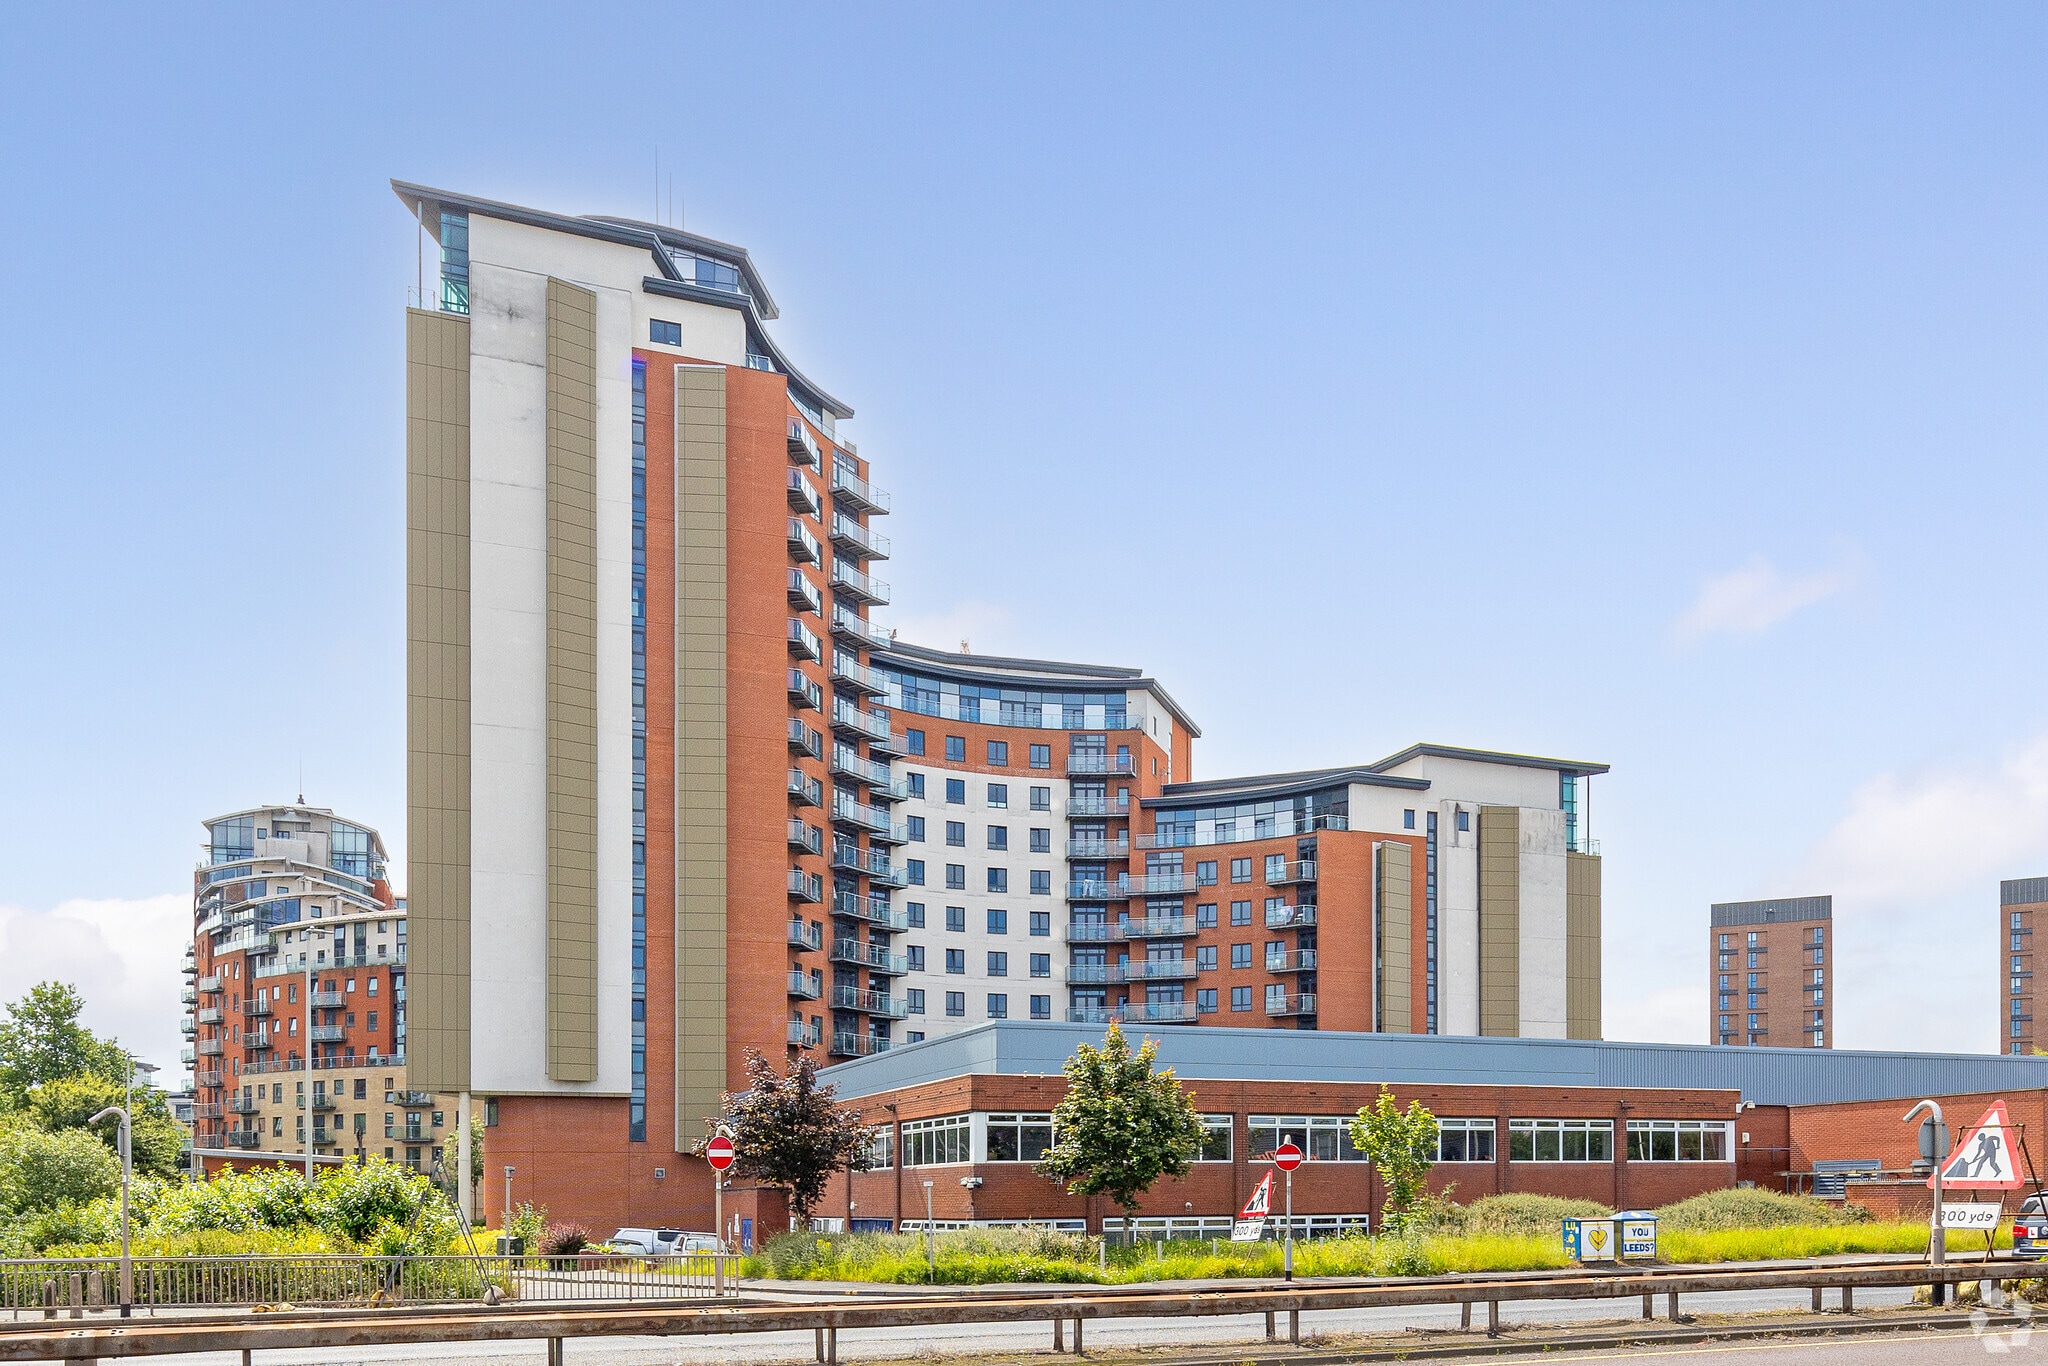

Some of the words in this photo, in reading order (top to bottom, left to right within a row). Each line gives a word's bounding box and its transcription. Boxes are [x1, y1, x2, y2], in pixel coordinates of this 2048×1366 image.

[1969, 1211, 1993, 1223] yds
[1234, 1225, 1249, 1236] 300
[1565, 1221, 1576, 1231] LU
[1631, 1228, 1649, 1237] YOU
[1624, 1243, 1655, 1252] LEEDS?
